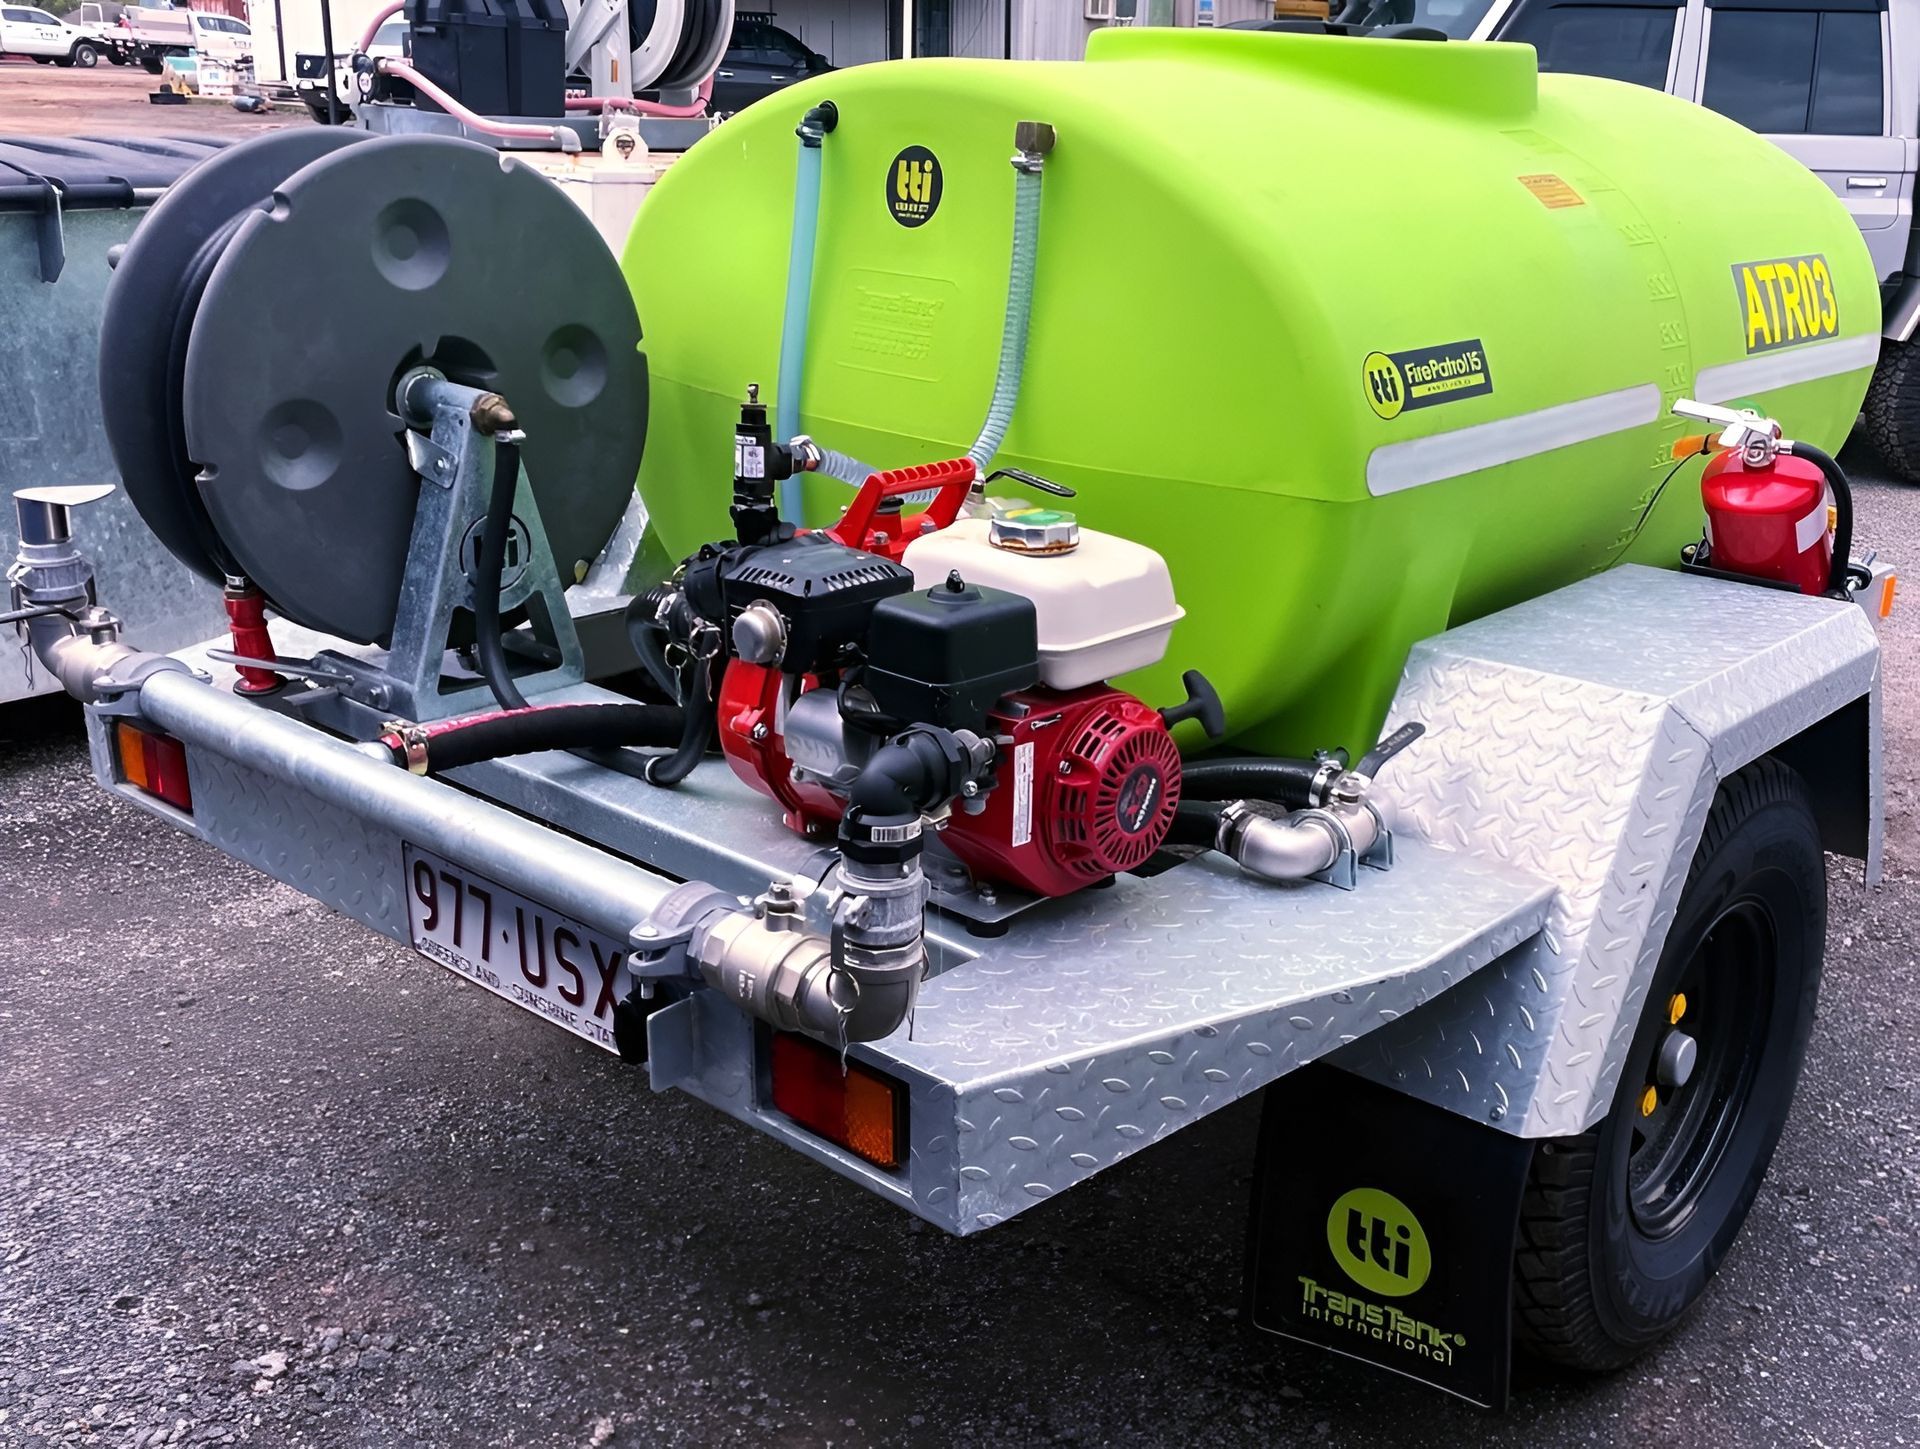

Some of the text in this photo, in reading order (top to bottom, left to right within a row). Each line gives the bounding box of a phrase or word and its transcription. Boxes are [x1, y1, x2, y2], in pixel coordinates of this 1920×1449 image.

[897, 160, 932, 203] tti
[1743, 258, 1837, 348] ATR03
[1369, 366, 1399, 404] tti
[1346, 1208, 1411, 1279] tti
[1302, 1301, 1452, 1366] International
